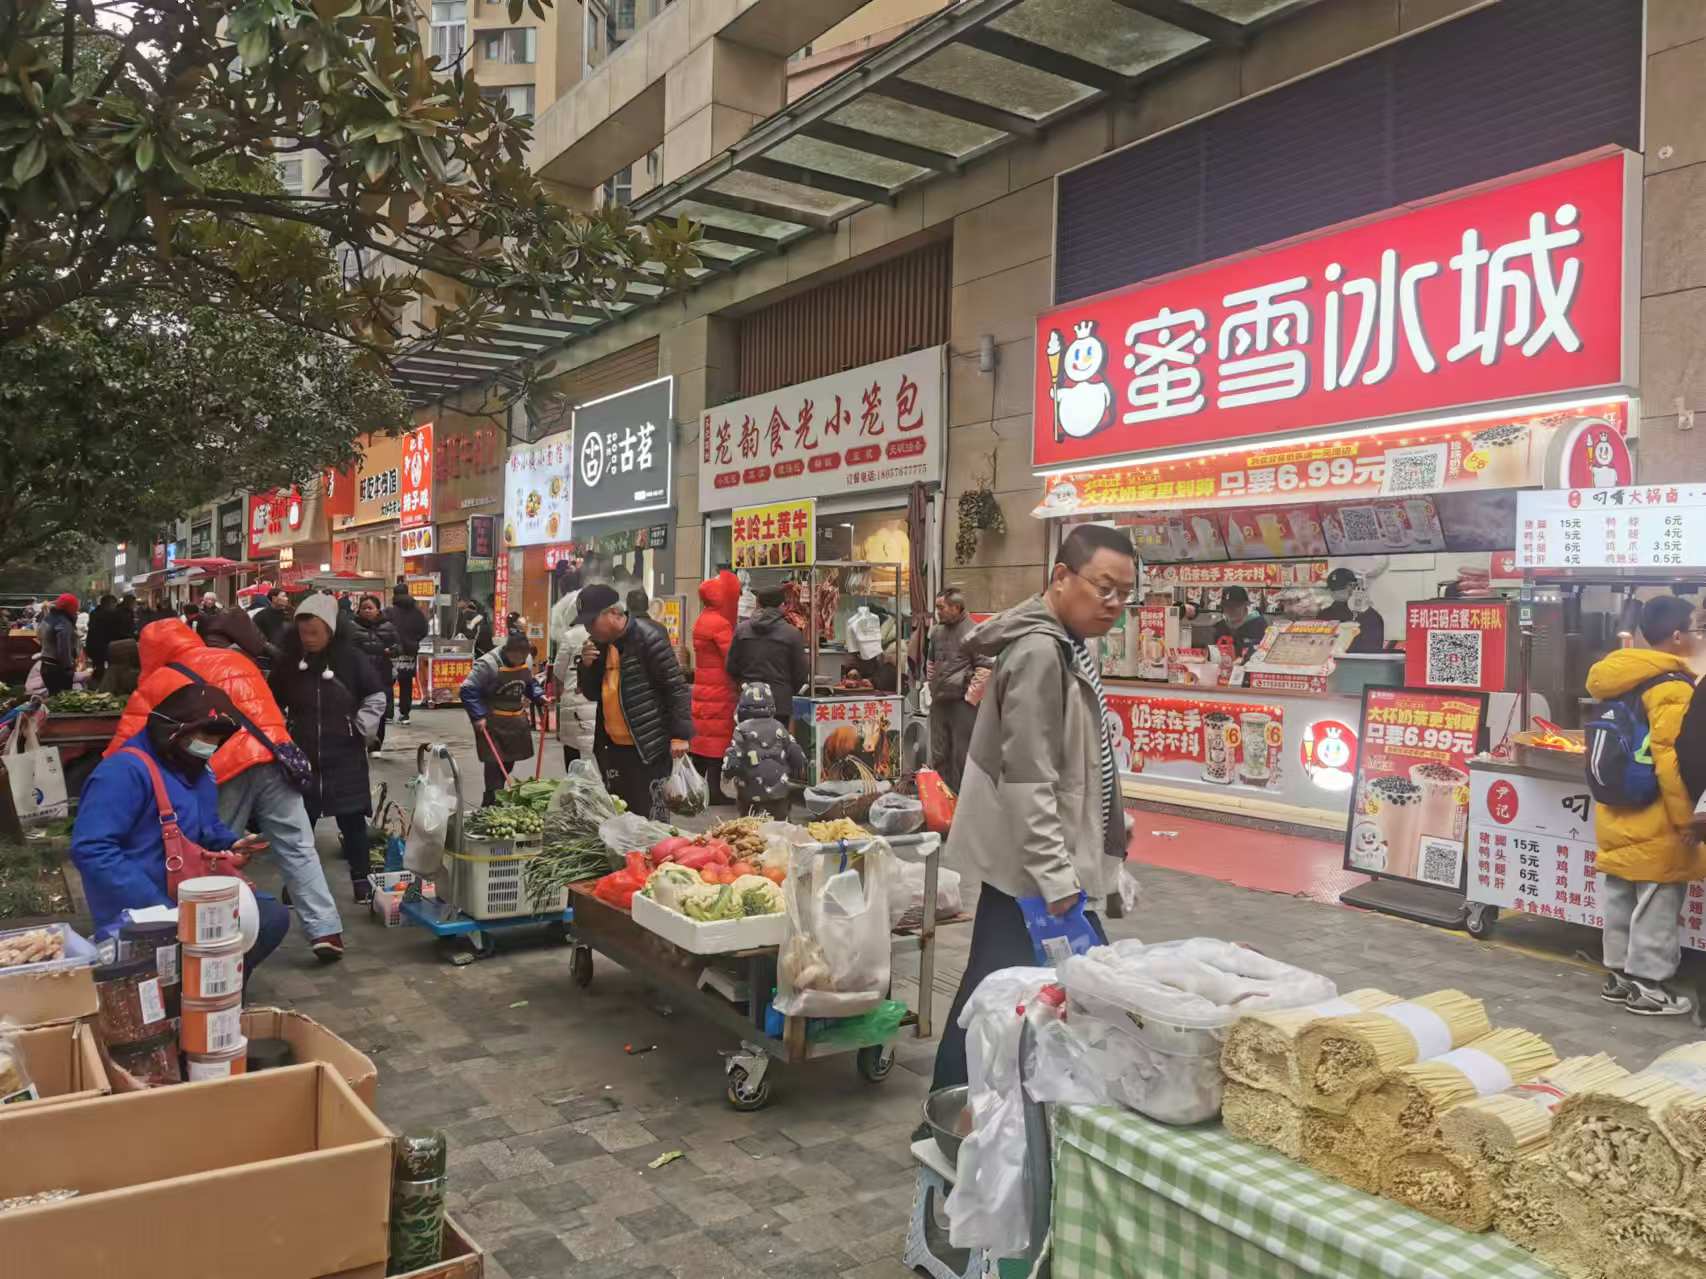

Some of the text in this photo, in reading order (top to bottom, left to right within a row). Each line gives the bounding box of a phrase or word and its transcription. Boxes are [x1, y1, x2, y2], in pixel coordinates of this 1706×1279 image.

[1122, 203, 1582, 425] 蜜雪冰城
[618, 421, 656, 473] 古茗
[1217, 457, 1386, 497] 只要6.99元
[1560, 519, 1581, 529] 15元
[1664, 515, 1683, 526] 6元
[1565, 530, 1581, 541] 5元
[1664, 527, 1683, 539] 4元
[1565, 542, 1581, 553] 6元
[1653, 540, 1682, 552] 3.5元
[1565, 554, 1581, 565] 4元
[1652, 553, 1682, 564] 0.5元
[1409, 607, 1503, 631] 手机扫码点餐不排队
[815, 701, 893, 722] 关岭土黄牛
[1131, 703, 1201, 733] 奶茶在手
[1132, 730, 1200, 757] 天冷不抖
[1365, 722, 1475, 754] 只要6.99元
[1478, 846, 1507, 861] 鸭头
[1520, 854, 1540, 868] 5元
[1513, 839, 1540, 854] 15元
[1478, 874, 1596, 909] 鸭肝 4元 鸡翅尖
[1520, 868, 1540, 882] 6元
[1556, 875, 1596, 894] 鸡爪
[1580, 912, 1604, 928] 138
